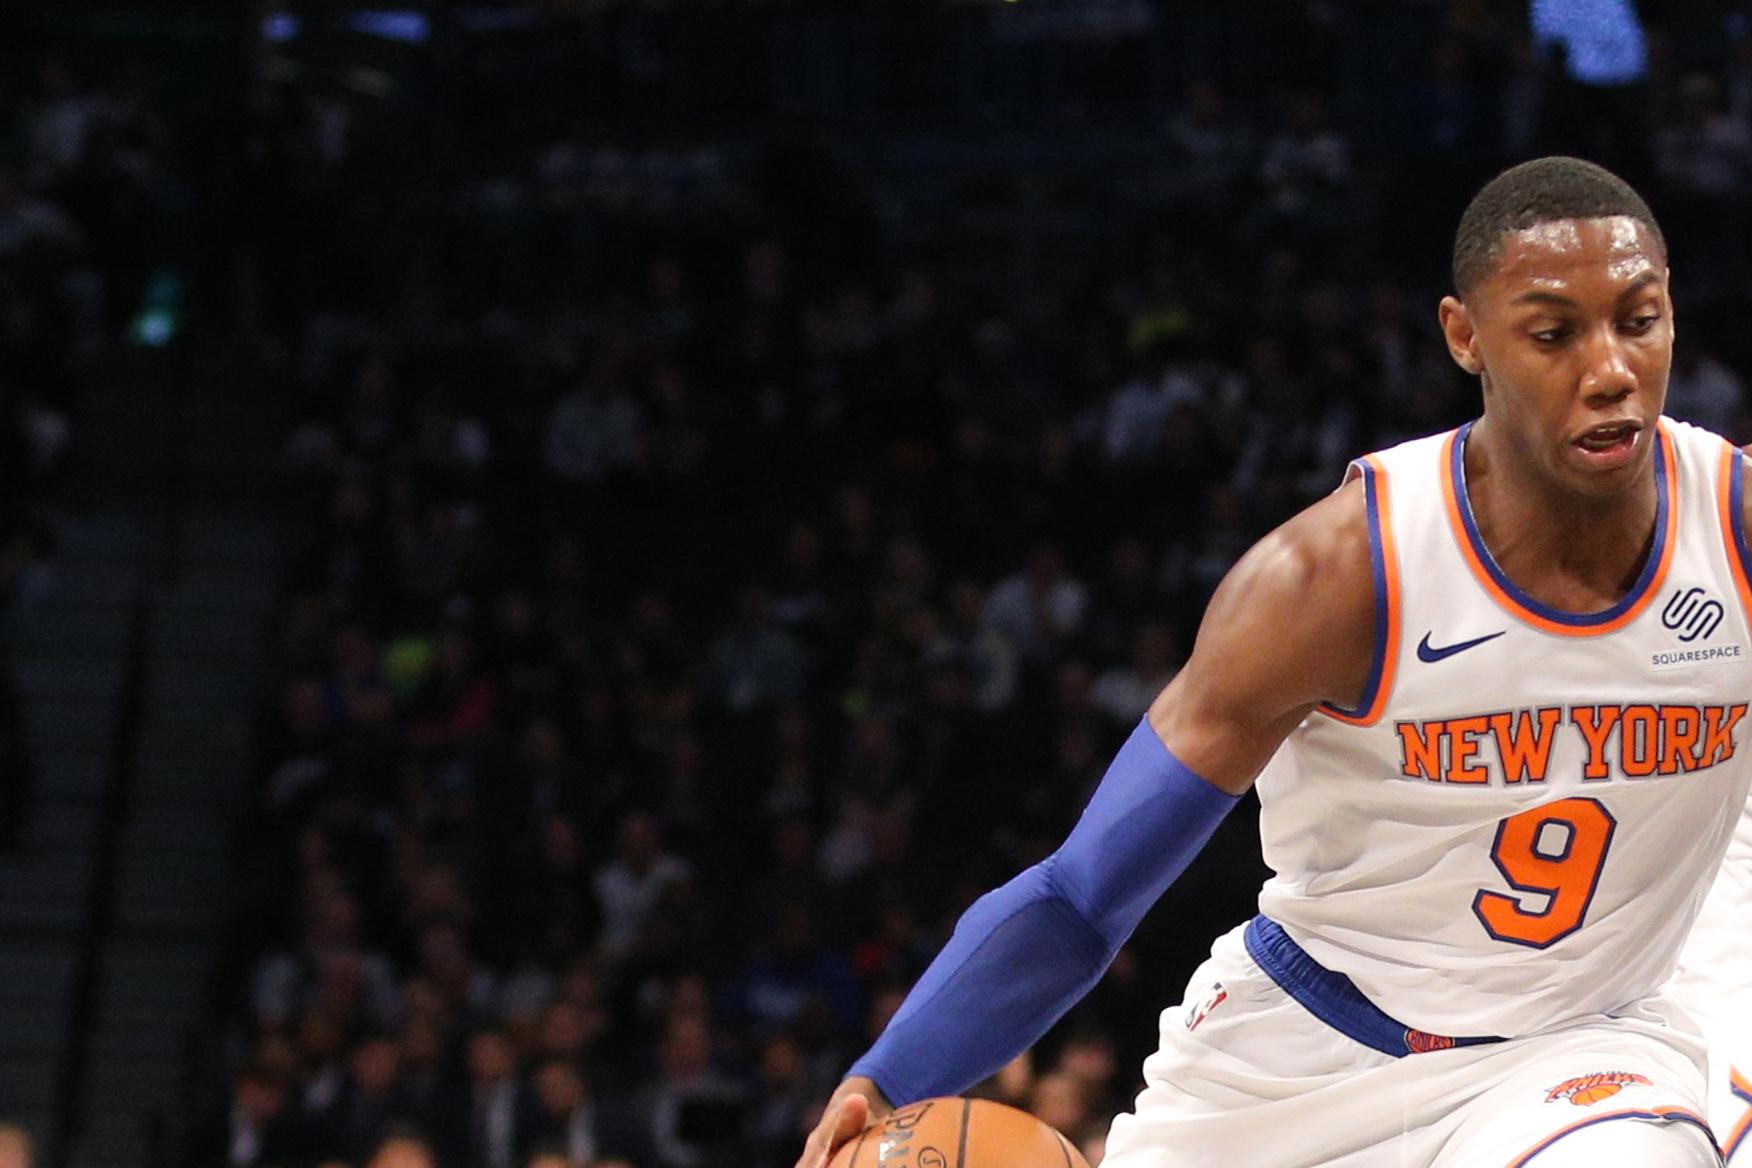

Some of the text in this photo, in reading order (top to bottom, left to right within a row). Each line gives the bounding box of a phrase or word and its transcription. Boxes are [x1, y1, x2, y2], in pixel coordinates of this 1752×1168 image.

[1651, 645, 1741, 665] SQUARESPACE
[1395, 701, 1750, 786] NEW YORK
[1471, 796, 1618, 950] 9
